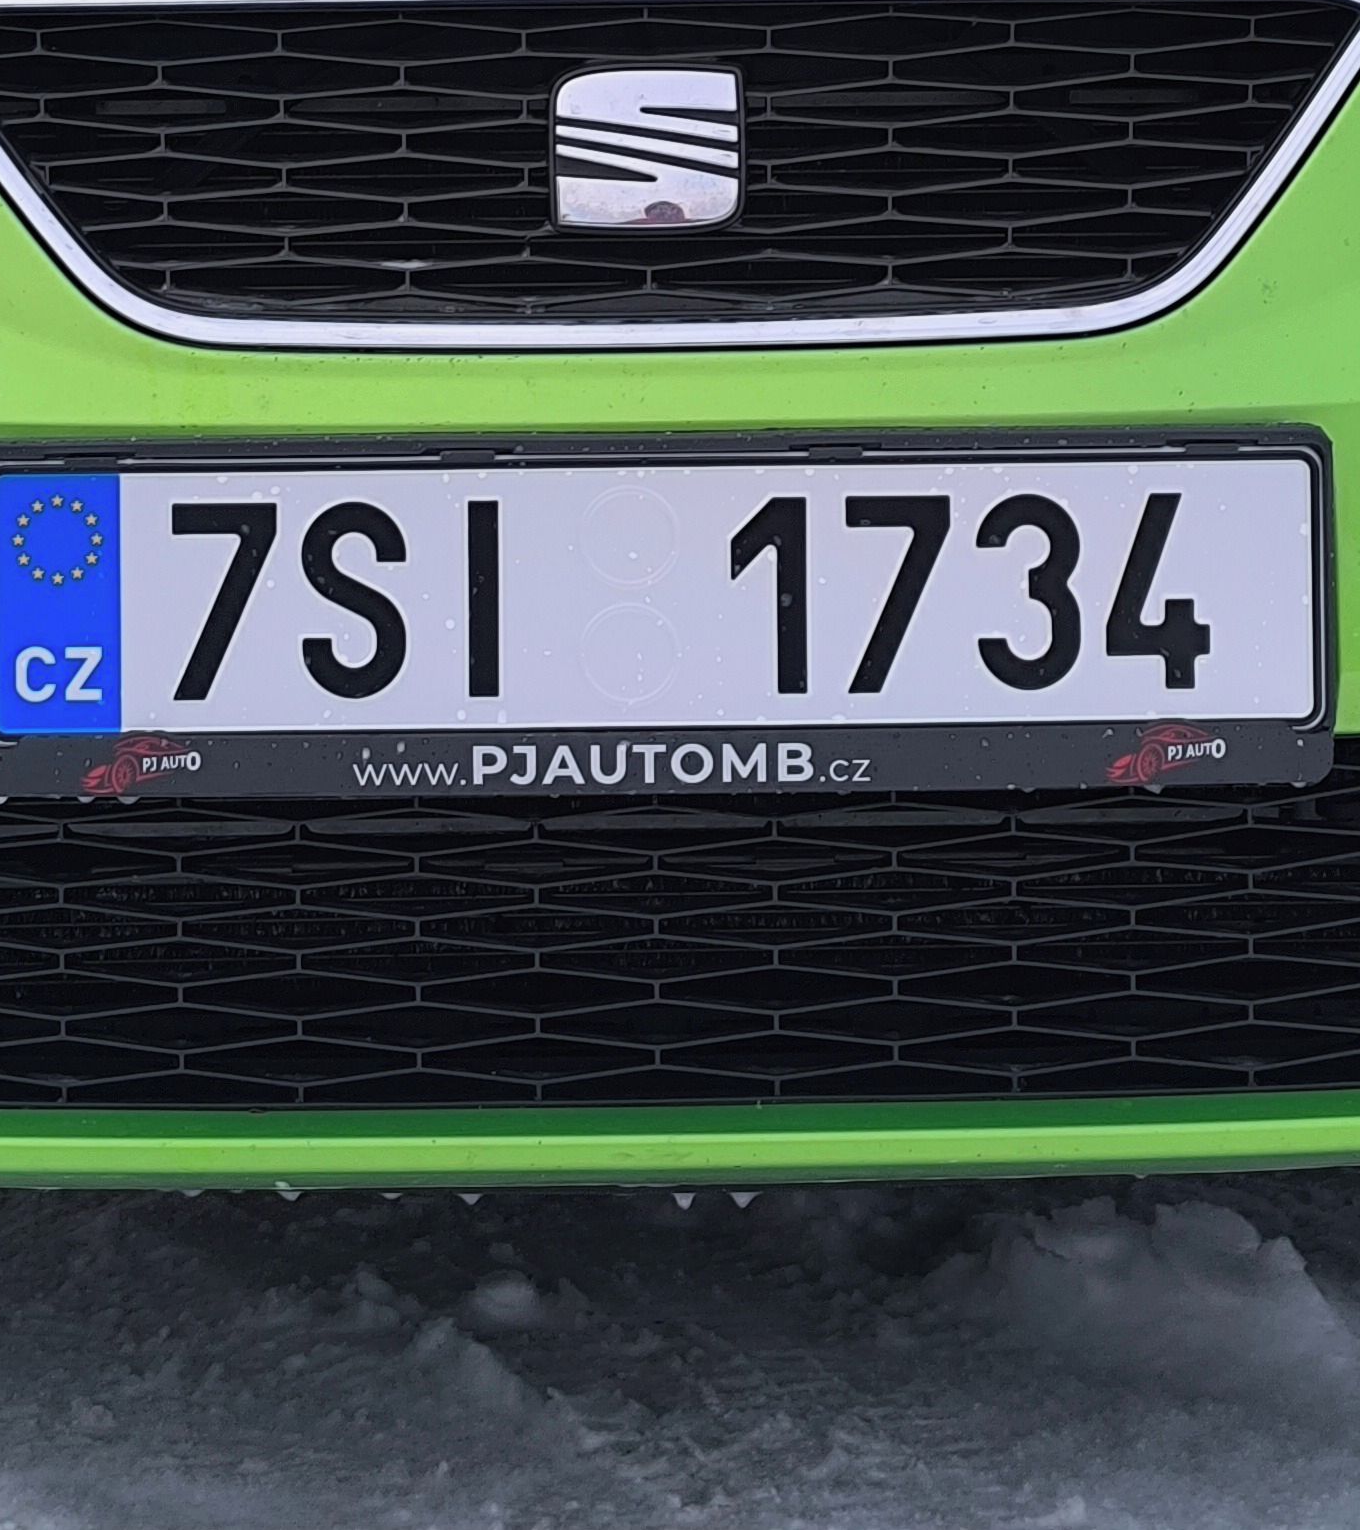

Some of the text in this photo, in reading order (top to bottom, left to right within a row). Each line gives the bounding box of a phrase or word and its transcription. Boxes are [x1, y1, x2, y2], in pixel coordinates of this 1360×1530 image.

[171, 492, 1211, 701] 7SI 1734
[15, 646, 104, 704] CZ
[142, 751, 202, 773] PJ AUTO
[352, 742, 871, 786] www.PJAUTOMB.cz
[1167, 738, 1227, 762] PJ AUTO
